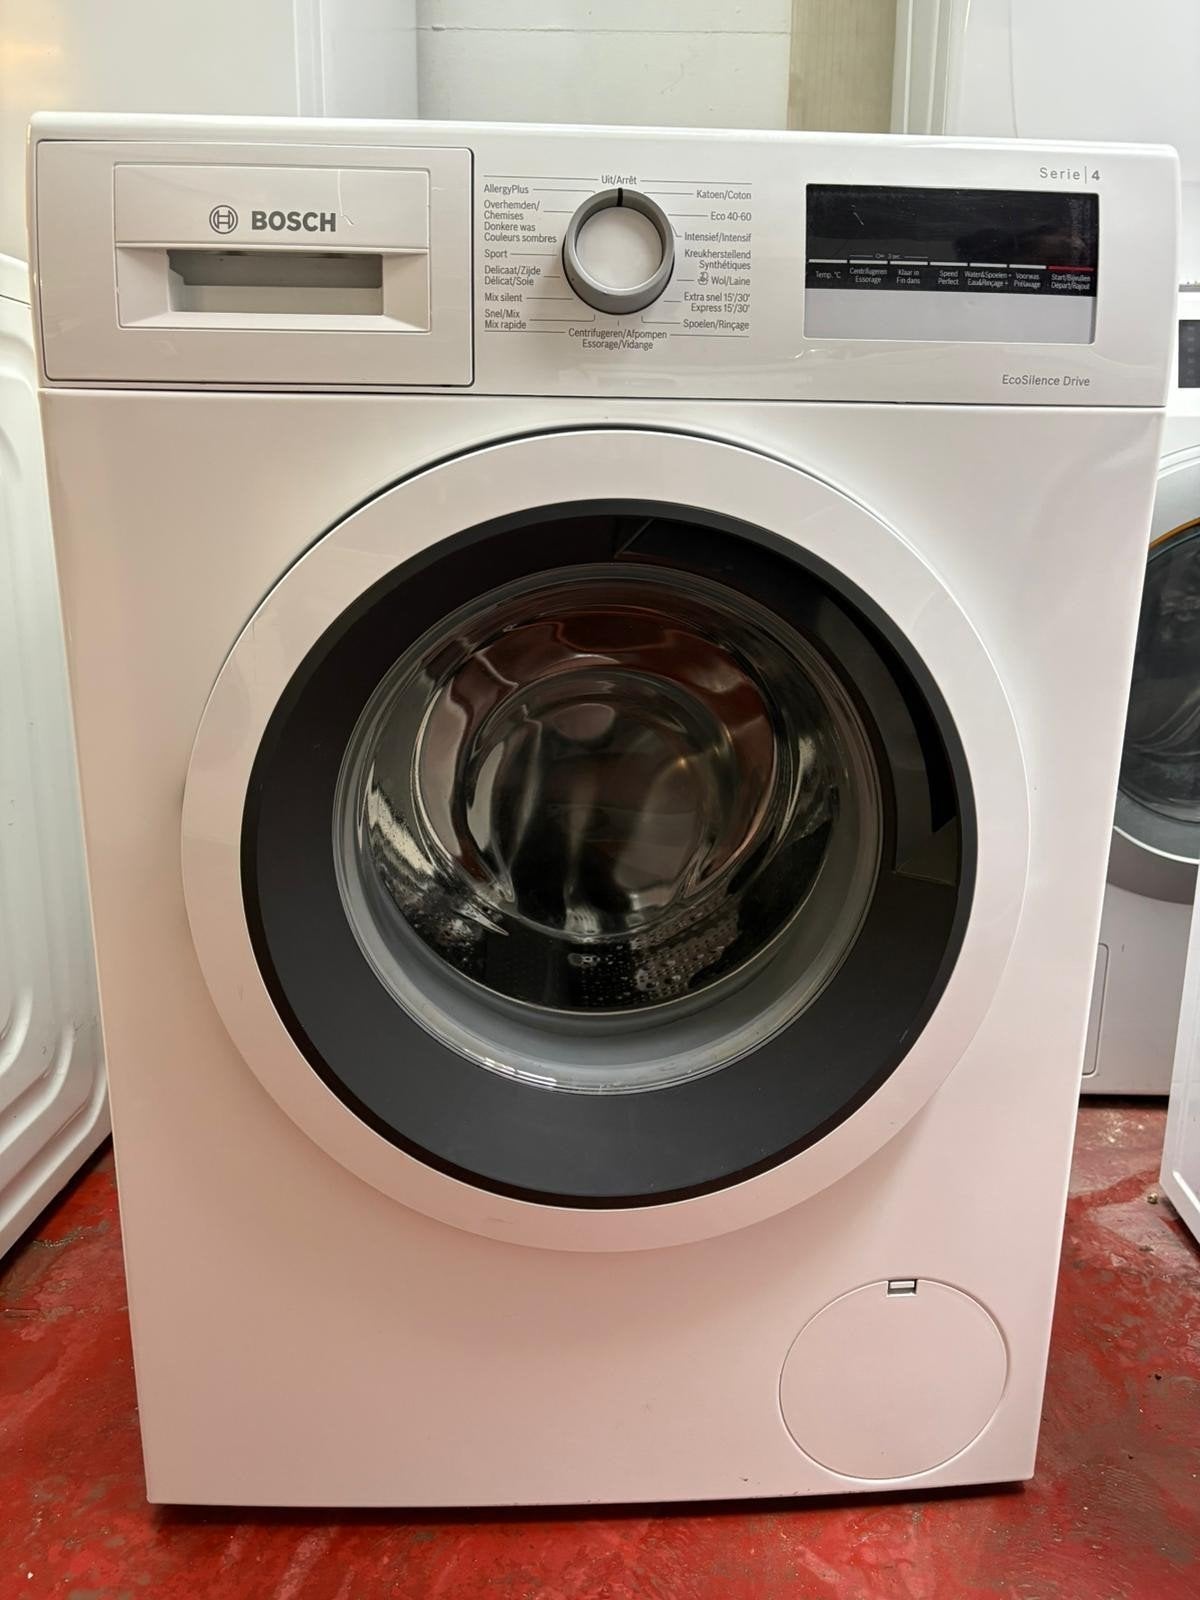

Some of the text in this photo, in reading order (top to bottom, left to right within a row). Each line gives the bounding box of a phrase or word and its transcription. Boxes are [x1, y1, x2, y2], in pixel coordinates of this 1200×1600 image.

[1039, 167, 1080, 180] Serie
[601, 174, 637, 185] Uit/Arrêt
[483, 183, 529, 195] AllergyPlus
[696, 189, 752, 200] Katoen/Coton
[483, 199, 540, 211] Overhemden/
[483, 210, 524, 220] Chemises
[710, 211, 752, 221] Eco 40-60
[251, 210, 336, 232] BOSCH
[483, 221, 536, 231] Donkere was
[483, 232, 557, 243] Couleurs sombres
[684, 231, 751, 243] Intensief/Intensif
[483, 248, 508, 259] Sport
[684, 248, 751, 259] Kreukherstellend
[484, 264, 541, 277] Delicaat/Zijde
[699, 260, 751, 271] Synthétiques
[815, 270, 833, 279] Temp.
[939, 270, 959, 278] Speed
[484, 275, 534, 286] Délicat/Soie
[711, 276, 751, 287] Wol/Laine
[855, 275, 881, 285] Essorage
[484, 292, 523, 302] Mix silent
[684, 291, 705, 301] Extra
[706, 293, 723, 302] snel
[484, 308, 520, 318] Snel/Mix
[691, 303, 722, 313] Express
[484, 319, 526, 330] Mix rapide
[683, 318, 749, 331] Spoelen/Rinçage
[568, 327, 667, 339] Centrifugeren/Afpompen
[582, 338, 654, 351] Essorage/Vidange
[1002, 374, 1090, 386] EcoSilence Drive
